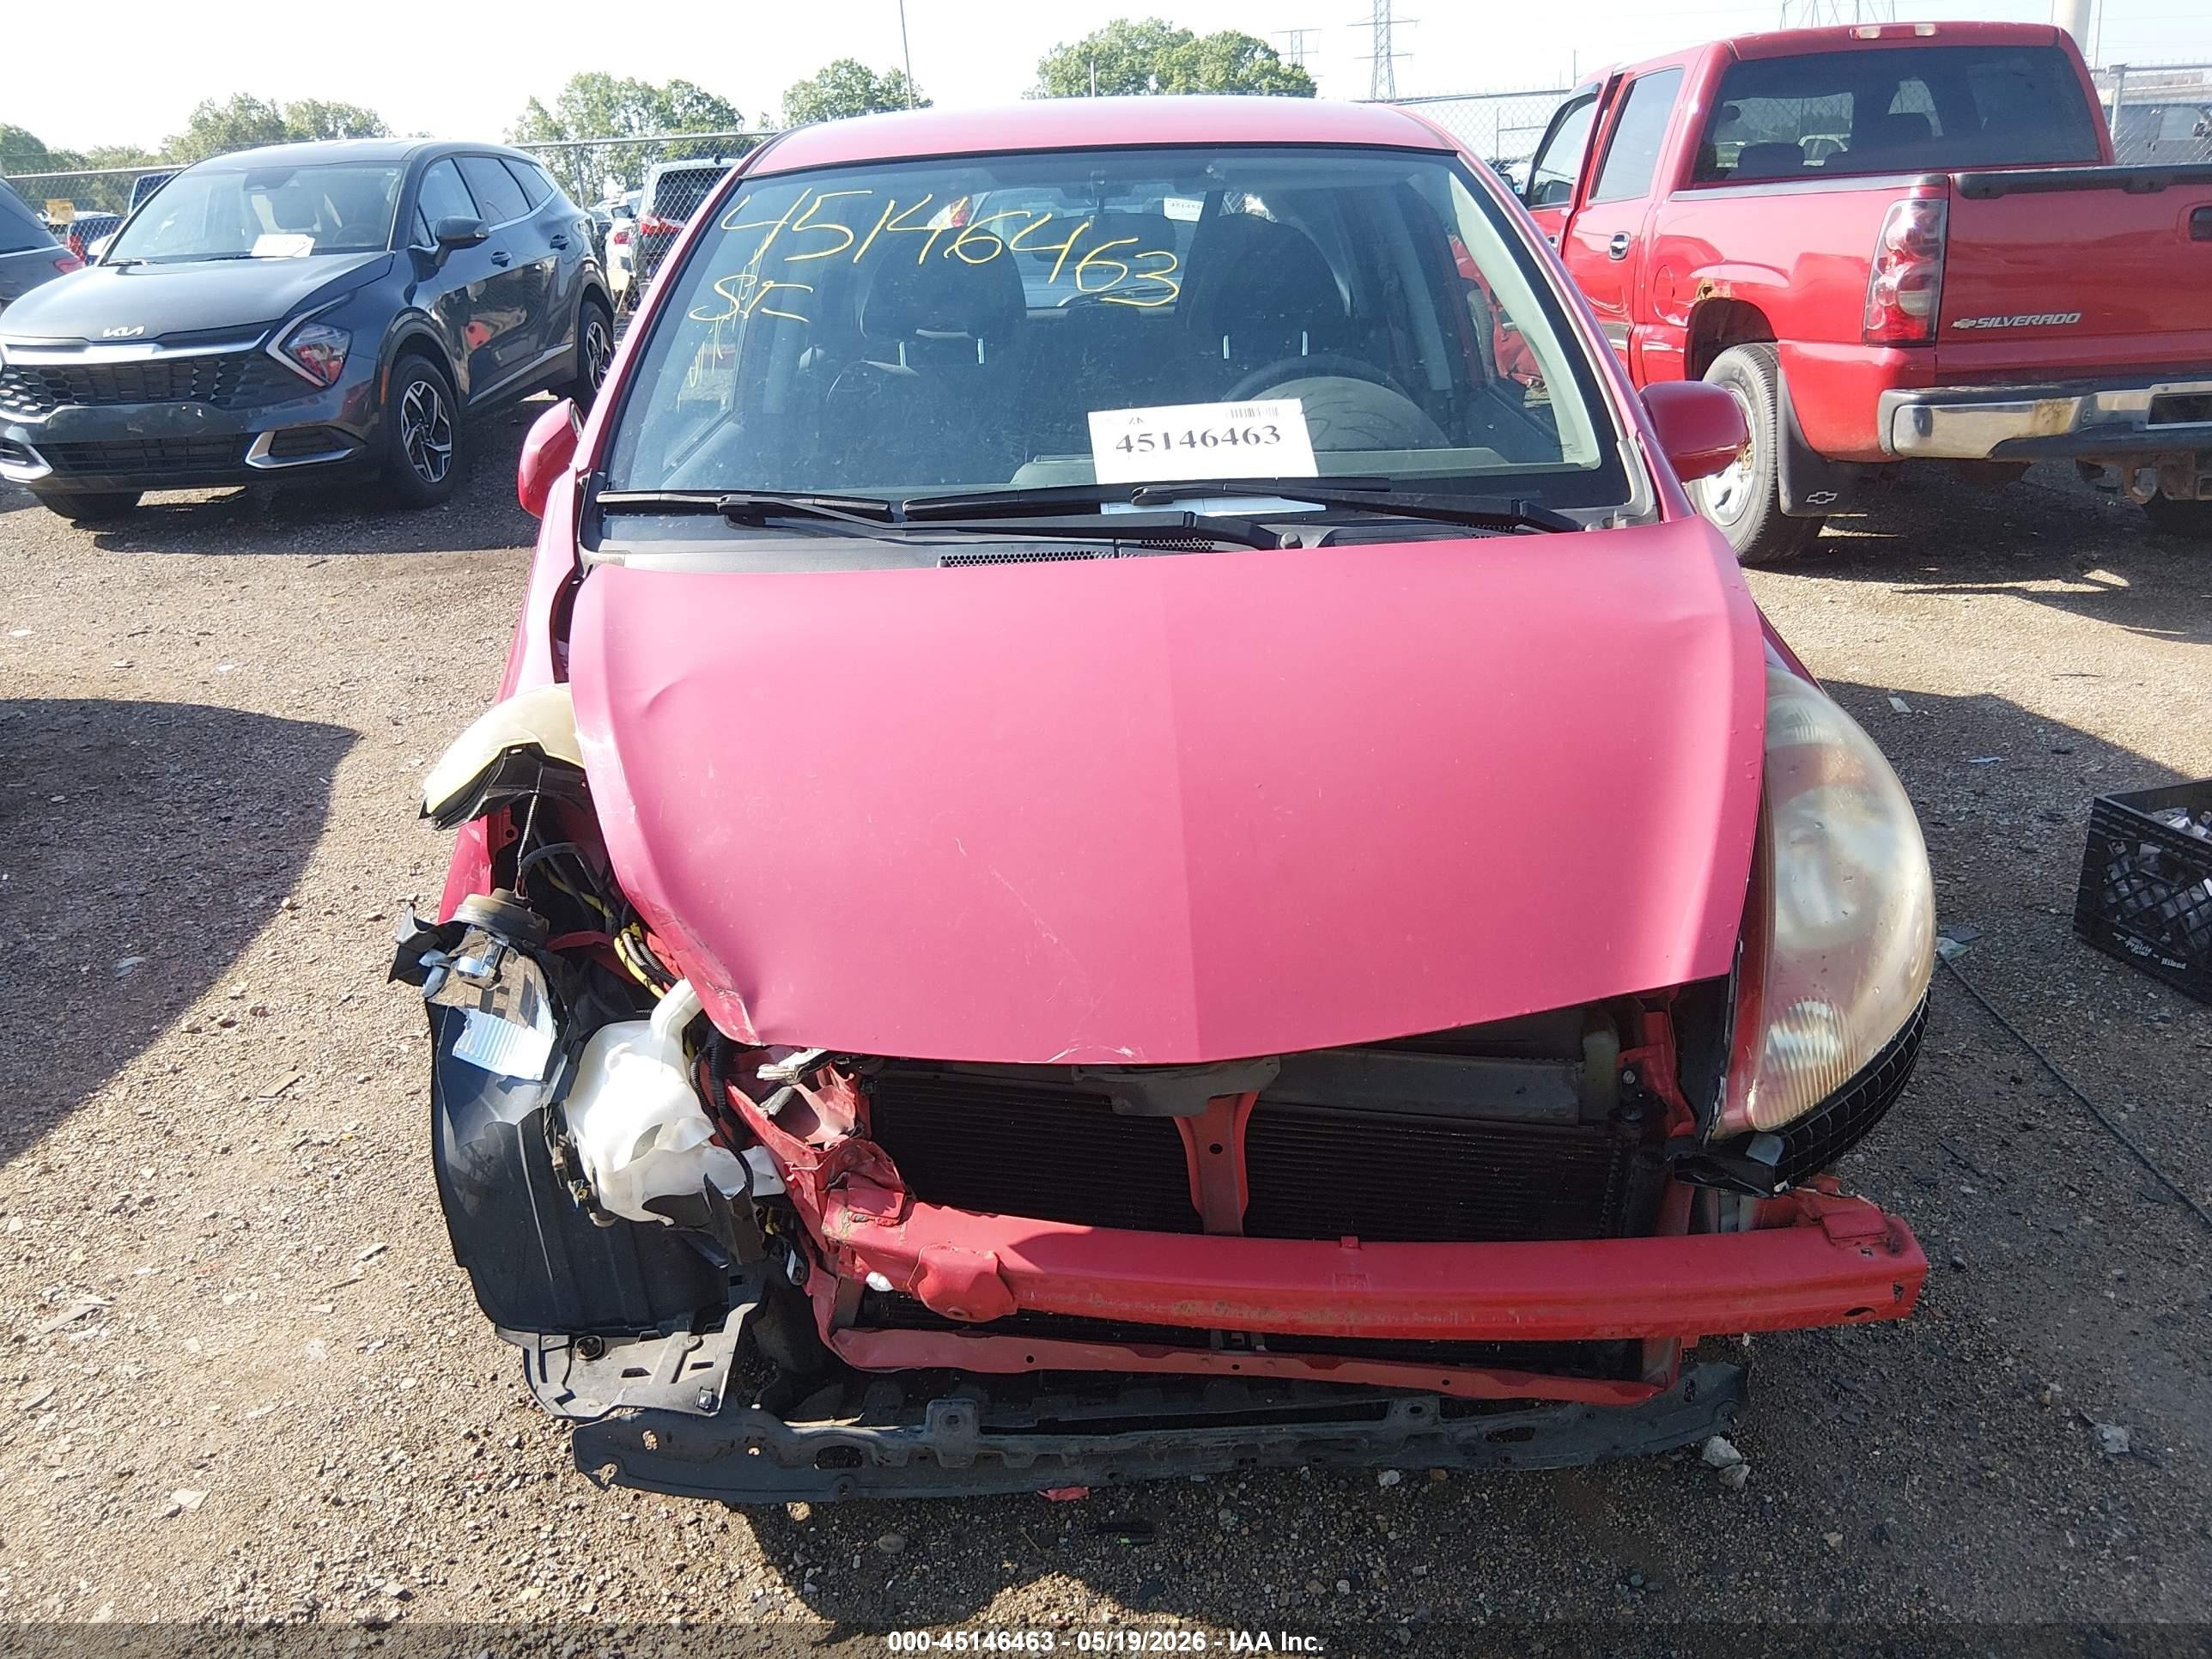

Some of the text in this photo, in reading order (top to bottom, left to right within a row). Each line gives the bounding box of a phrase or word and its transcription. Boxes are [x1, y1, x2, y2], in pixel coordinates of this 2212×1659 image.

[720, 187, 1181, 307] 45146463
[1974, 313, 2082, 329] SILVERADO
[1115, 424, 1281, 453] 45146463
